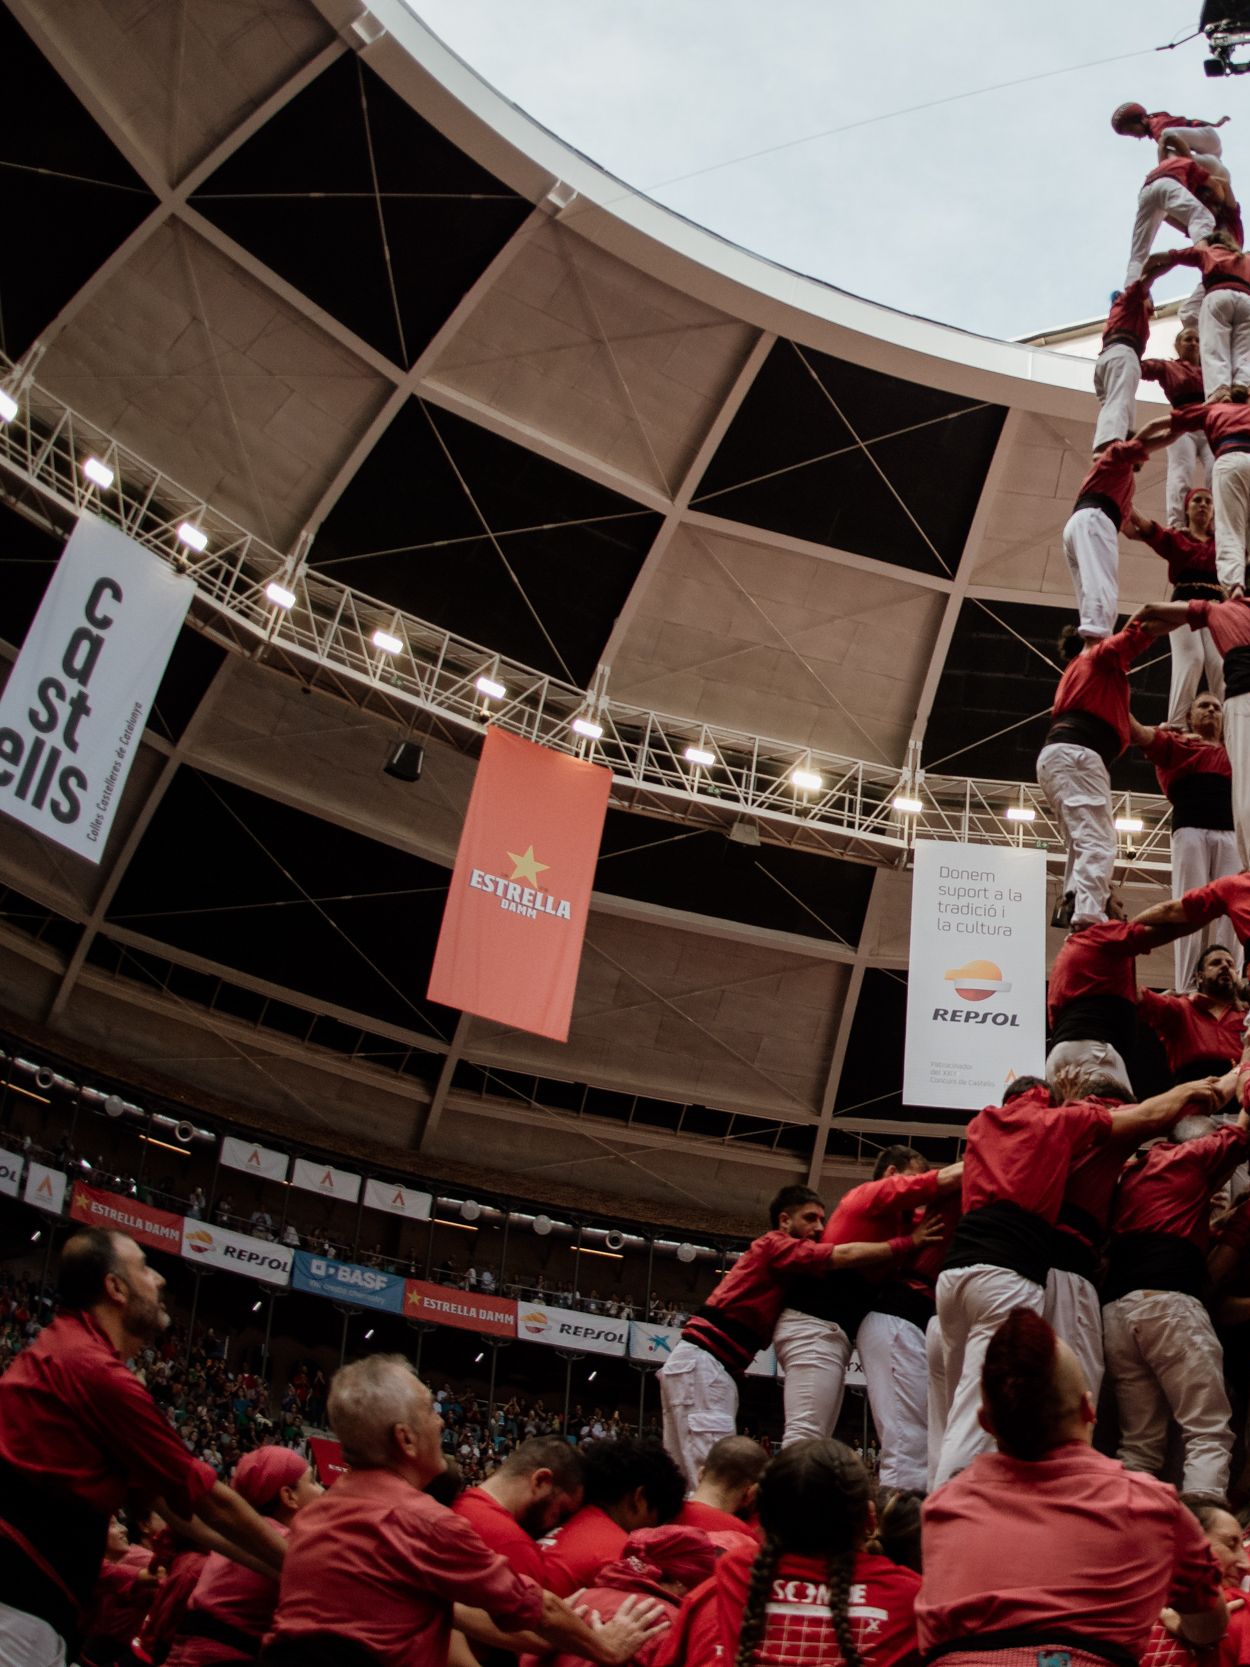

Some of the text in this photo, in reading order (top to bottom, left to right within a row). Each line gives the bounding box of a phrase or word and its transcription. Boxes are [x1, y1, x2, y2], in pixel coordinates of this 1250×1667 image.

[86, 701, 143, 842] Colles Castelleres de Catalunya
[939, 866, 995, 883] Donem
[469, 868, 571, 920] ESTRELLA
[938, 885, 1022, 902] suport a la
[500, 898, 537, 919] DAMM
[937, 902, 997, 918] tradició
[937, 918, 1012, 936] la cultura
[932, 1008, 1020, 1027] REPSOL
[90, 1202, 181, 1242] ESTRELLA DAMM
[223, 1244, 289, 1273] REPSOL
[337, 1265, 388, 1290] BASF
[423, 1297, 514, 1325] ESTRELLA DAMM
[559, 1323, 625, 1344] REPSOL
